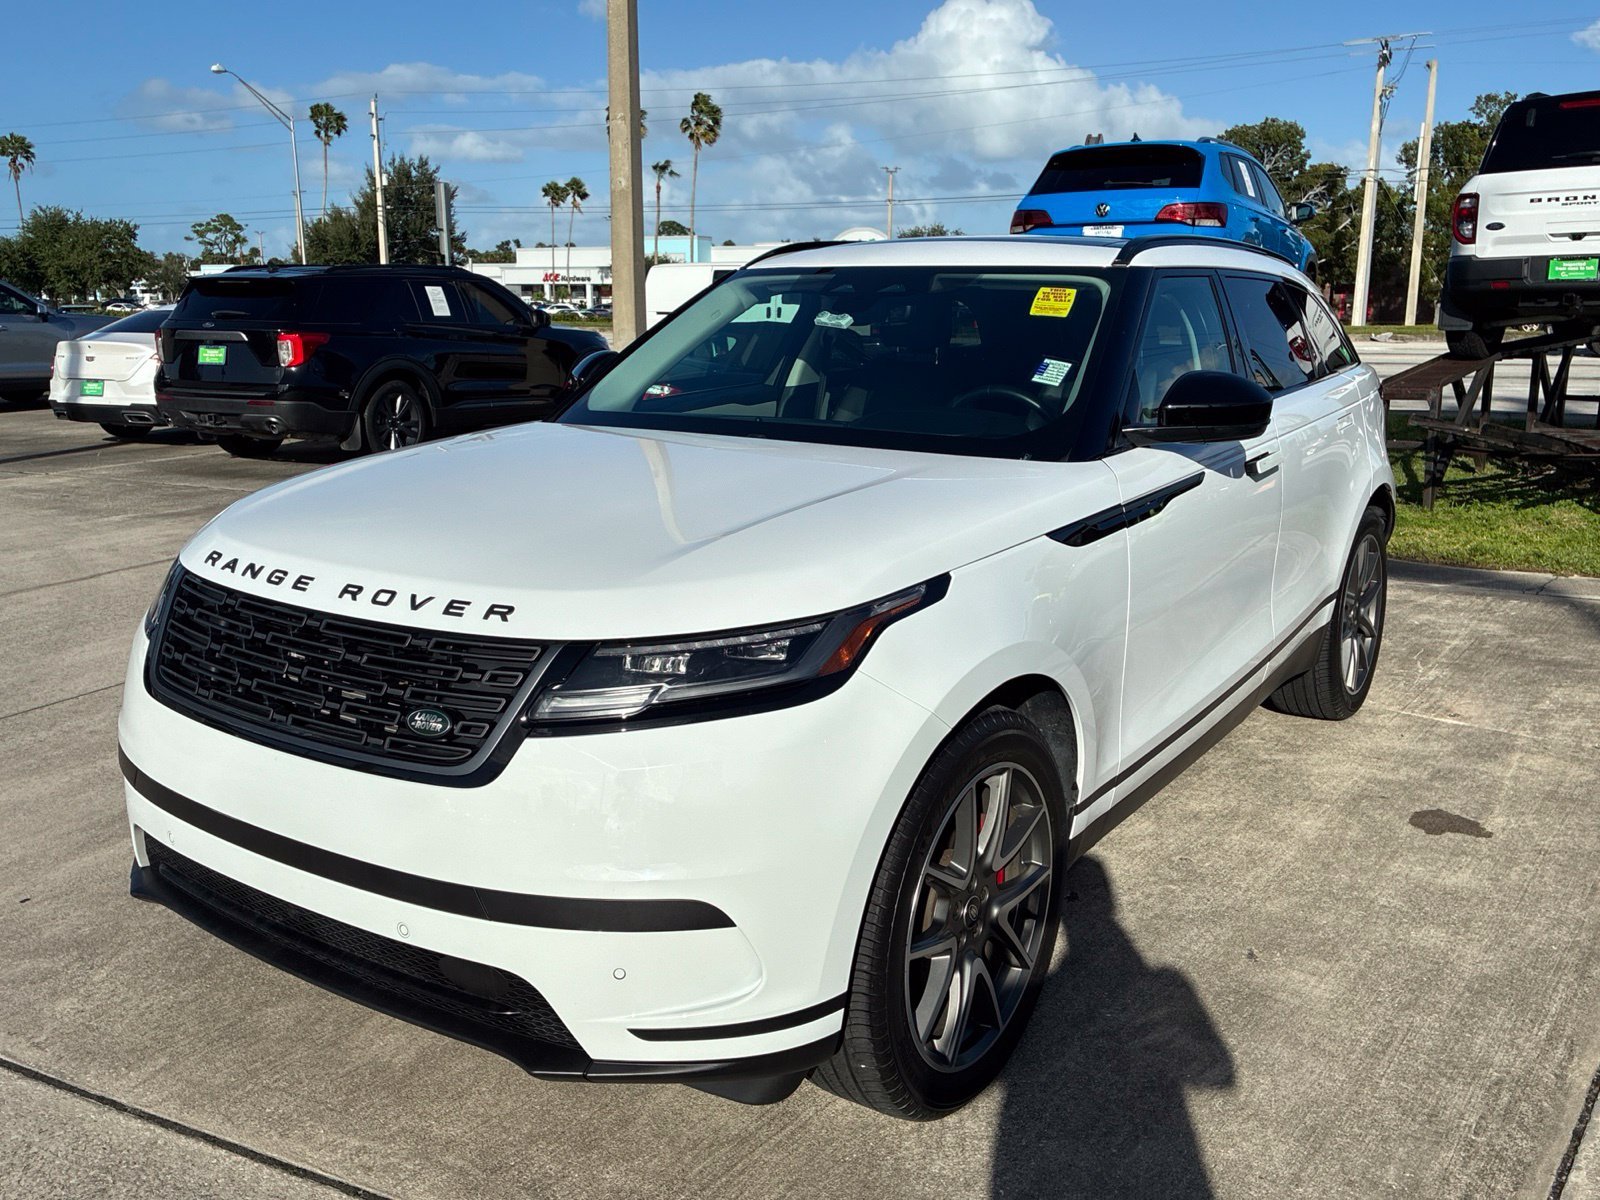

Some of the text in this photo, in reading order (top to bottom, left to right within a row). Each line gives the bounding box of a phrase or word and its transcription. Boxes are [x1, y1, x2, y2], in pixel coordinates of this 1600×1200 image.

[542, 272, 560, 282] ACE
[204, 550, 517, 623] RANGE ROVER
[414, 712, 437, 723] LAND
[414, 721, 443, 732] ROVER
